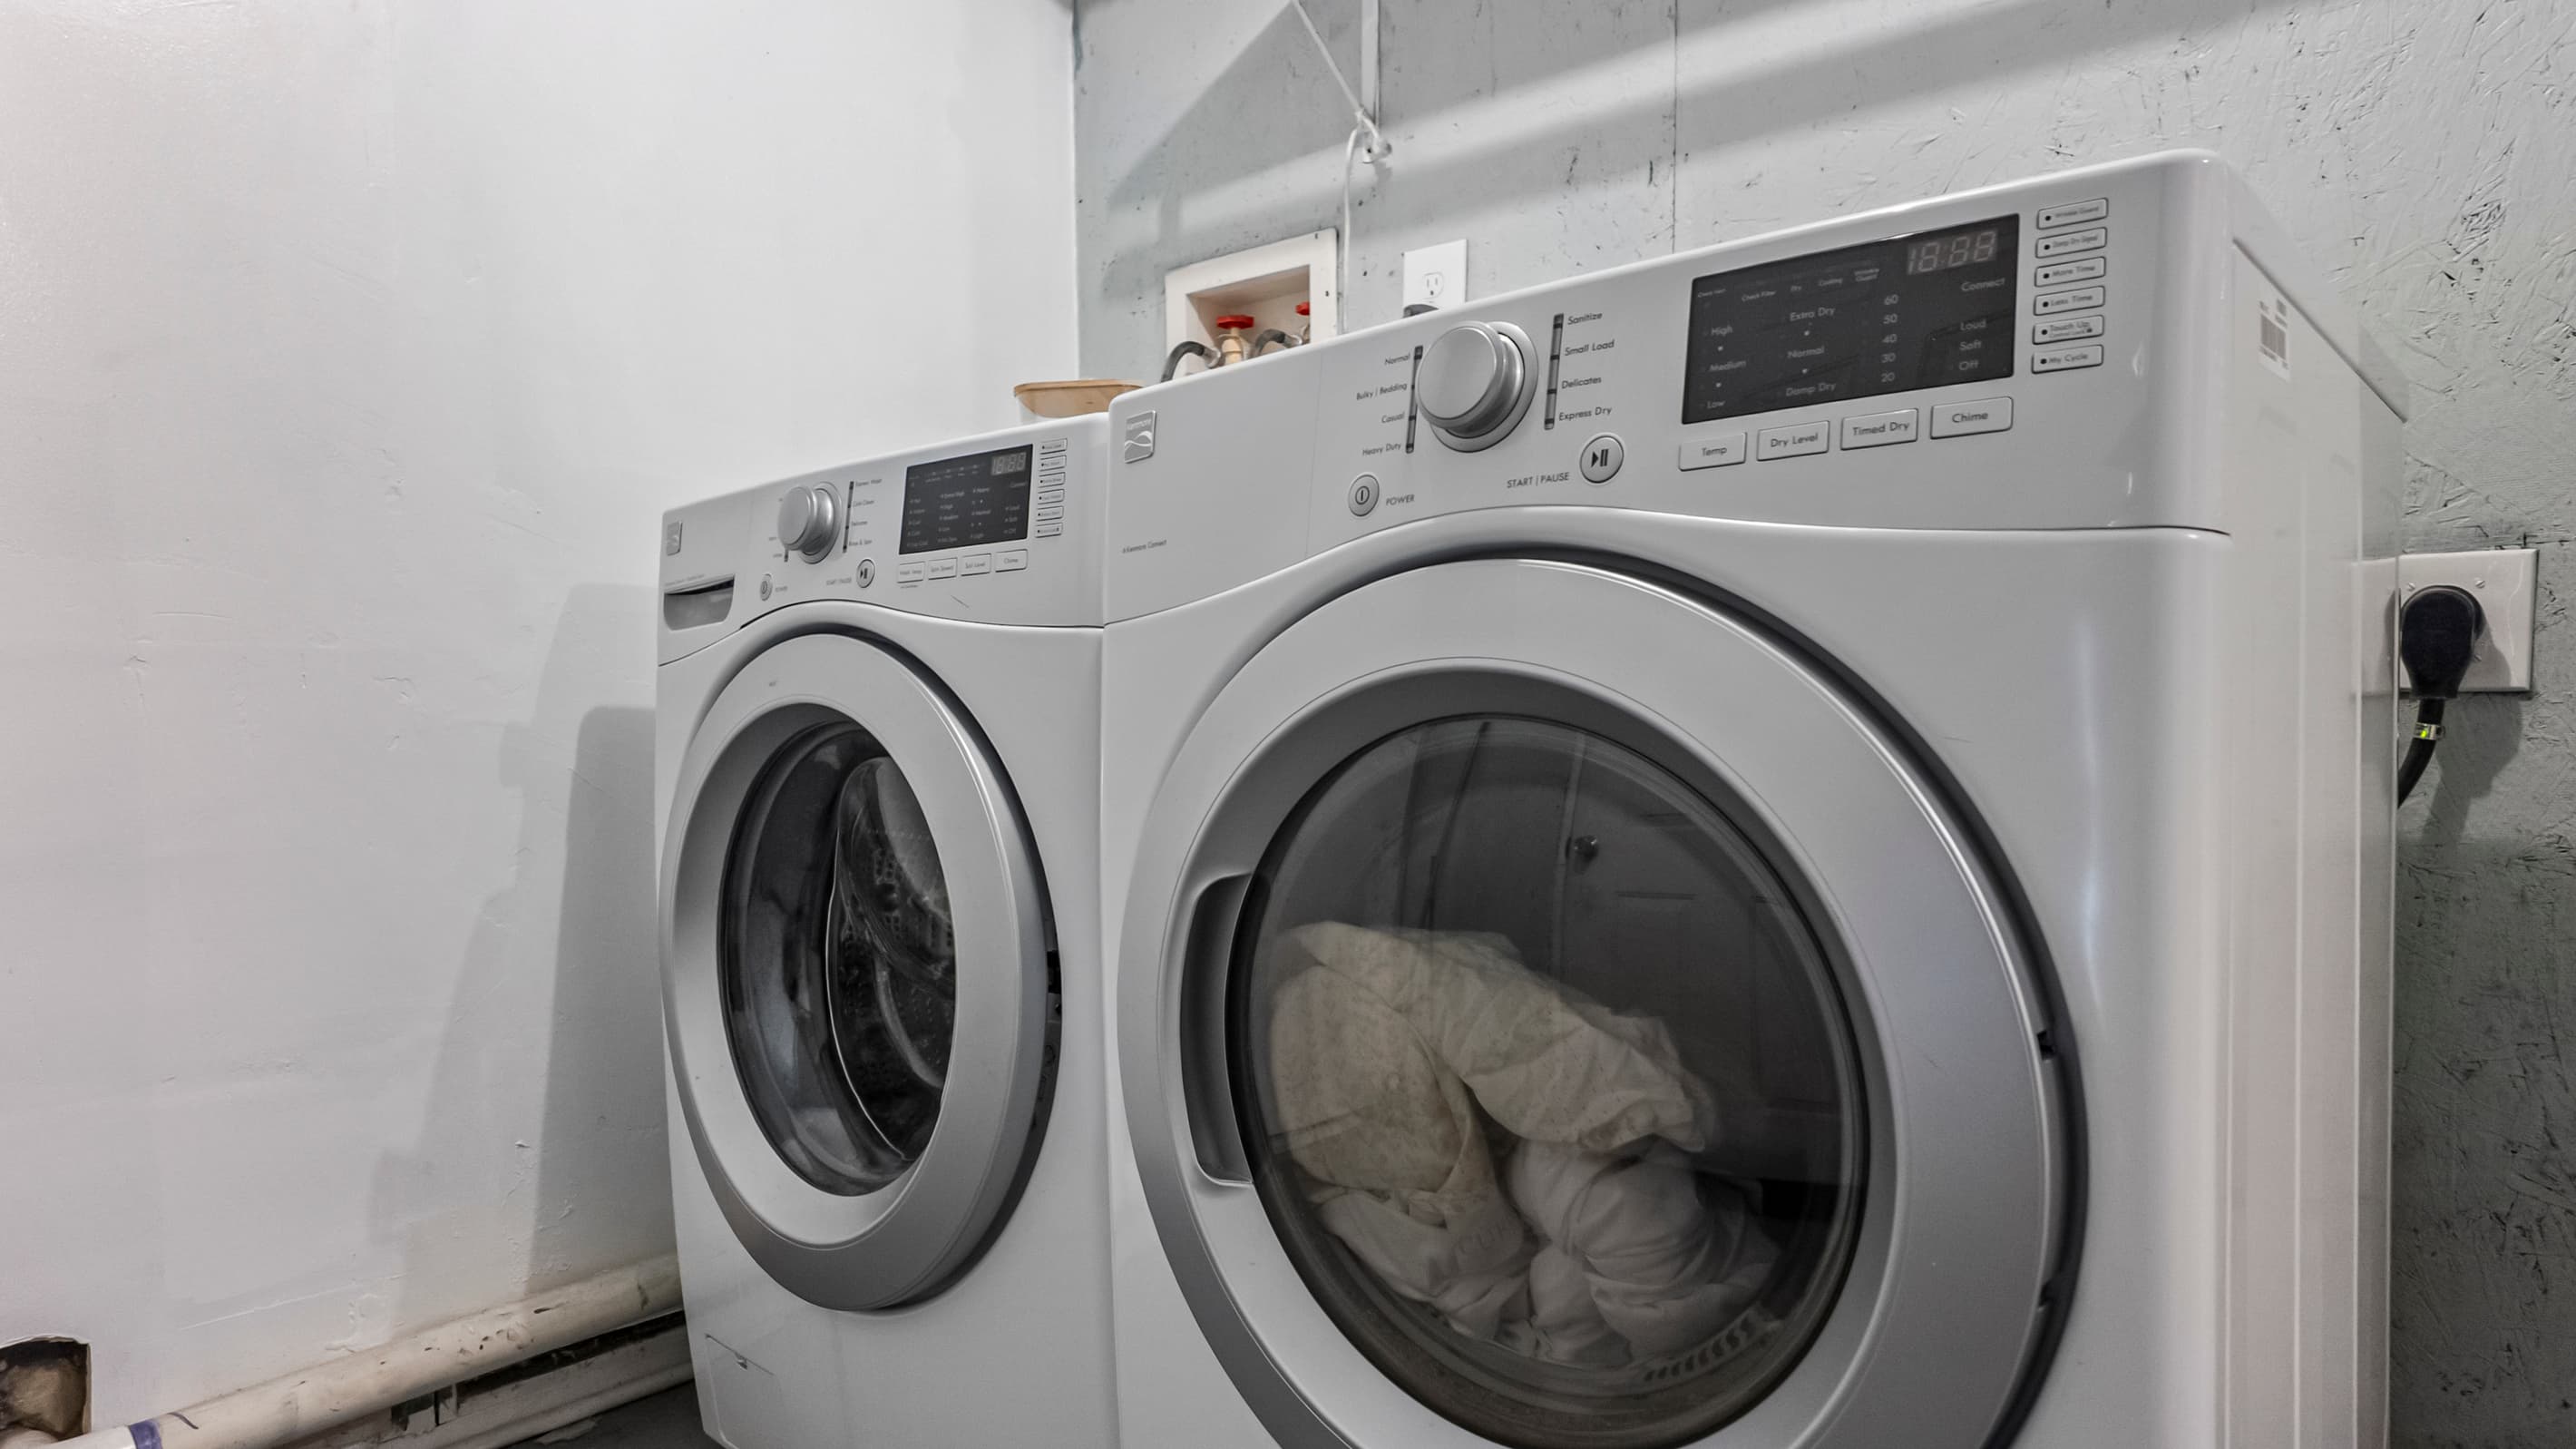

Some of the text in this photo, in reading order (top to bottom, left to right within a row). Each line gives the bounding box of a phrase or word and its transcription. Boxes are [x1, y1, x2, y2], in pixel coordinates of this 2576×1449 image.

[1884, 294, 1899, 305] 60
[1567, 312, 1603, 325] Sanitize
[1790, 307, 1836, 322] Extra Dry
[1883, 314, 1898, 325] 50
[1959, 318, 1987, 331] Loud
[1711, 325, 1733, 337] High
[1882, 334, 1897, 344] 40
[1958, 339, 1982, 351] Soft
[1565, 338, 1615, 356] Small Load
[1787, 346, 1825, 358] Normal
[1384, 351, 1410, 365] Normal
[1881, 353, 1897, 363] 30
[1709, 360, 1746, 372] Medium
[1958, 359, 1979, 370] Off
[1561, 377, 1602, 389] Delicates
[1880, 372, 1895, 383] 20
[1786, 382, 1836, 397] Damp Dry
[1707, 399, 1725, 409] Low
[1381, 411, 1405, 423] Casual
[1559, 406, 1612, 422] Express Dry
[1952, 411, 1988, 424] Chime
[1853, 421, 1909, 436] Timed Dry
[1771, 433, 1819, 448] Dry Level
[1702, 445, 1727, 457] Temp
[1507, 477, 1533, 488] START
[1541, 472, 1570, 485] PAUSE
[1386, 494, 1415, 505] POWER
